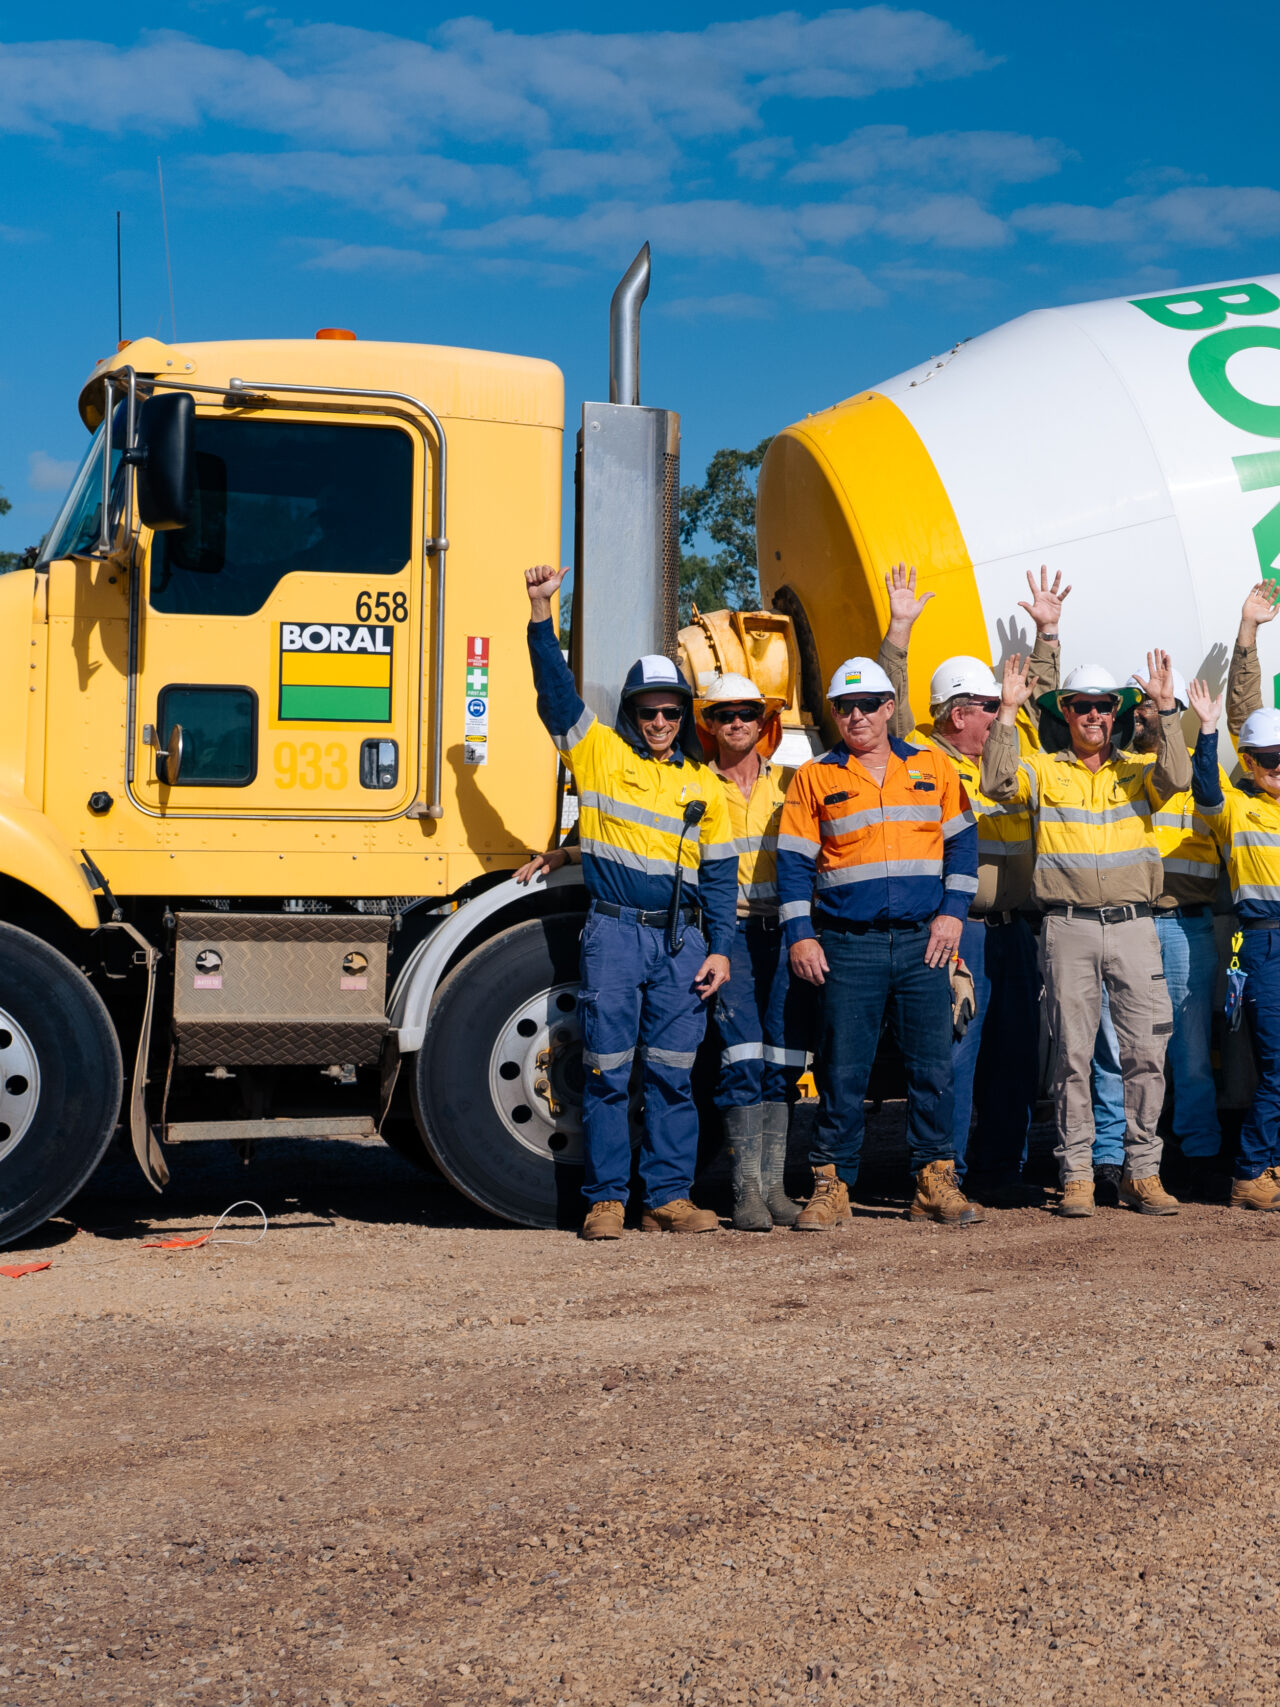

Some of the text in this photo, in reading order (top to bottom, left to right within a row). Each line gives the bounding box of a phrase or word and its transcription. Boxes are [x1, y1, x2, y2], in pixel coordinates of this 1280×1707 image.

[356, 590, 408, 623] 658
[282, 624, 391, 653] BORAL
[273, 741, 348, 790] 933
